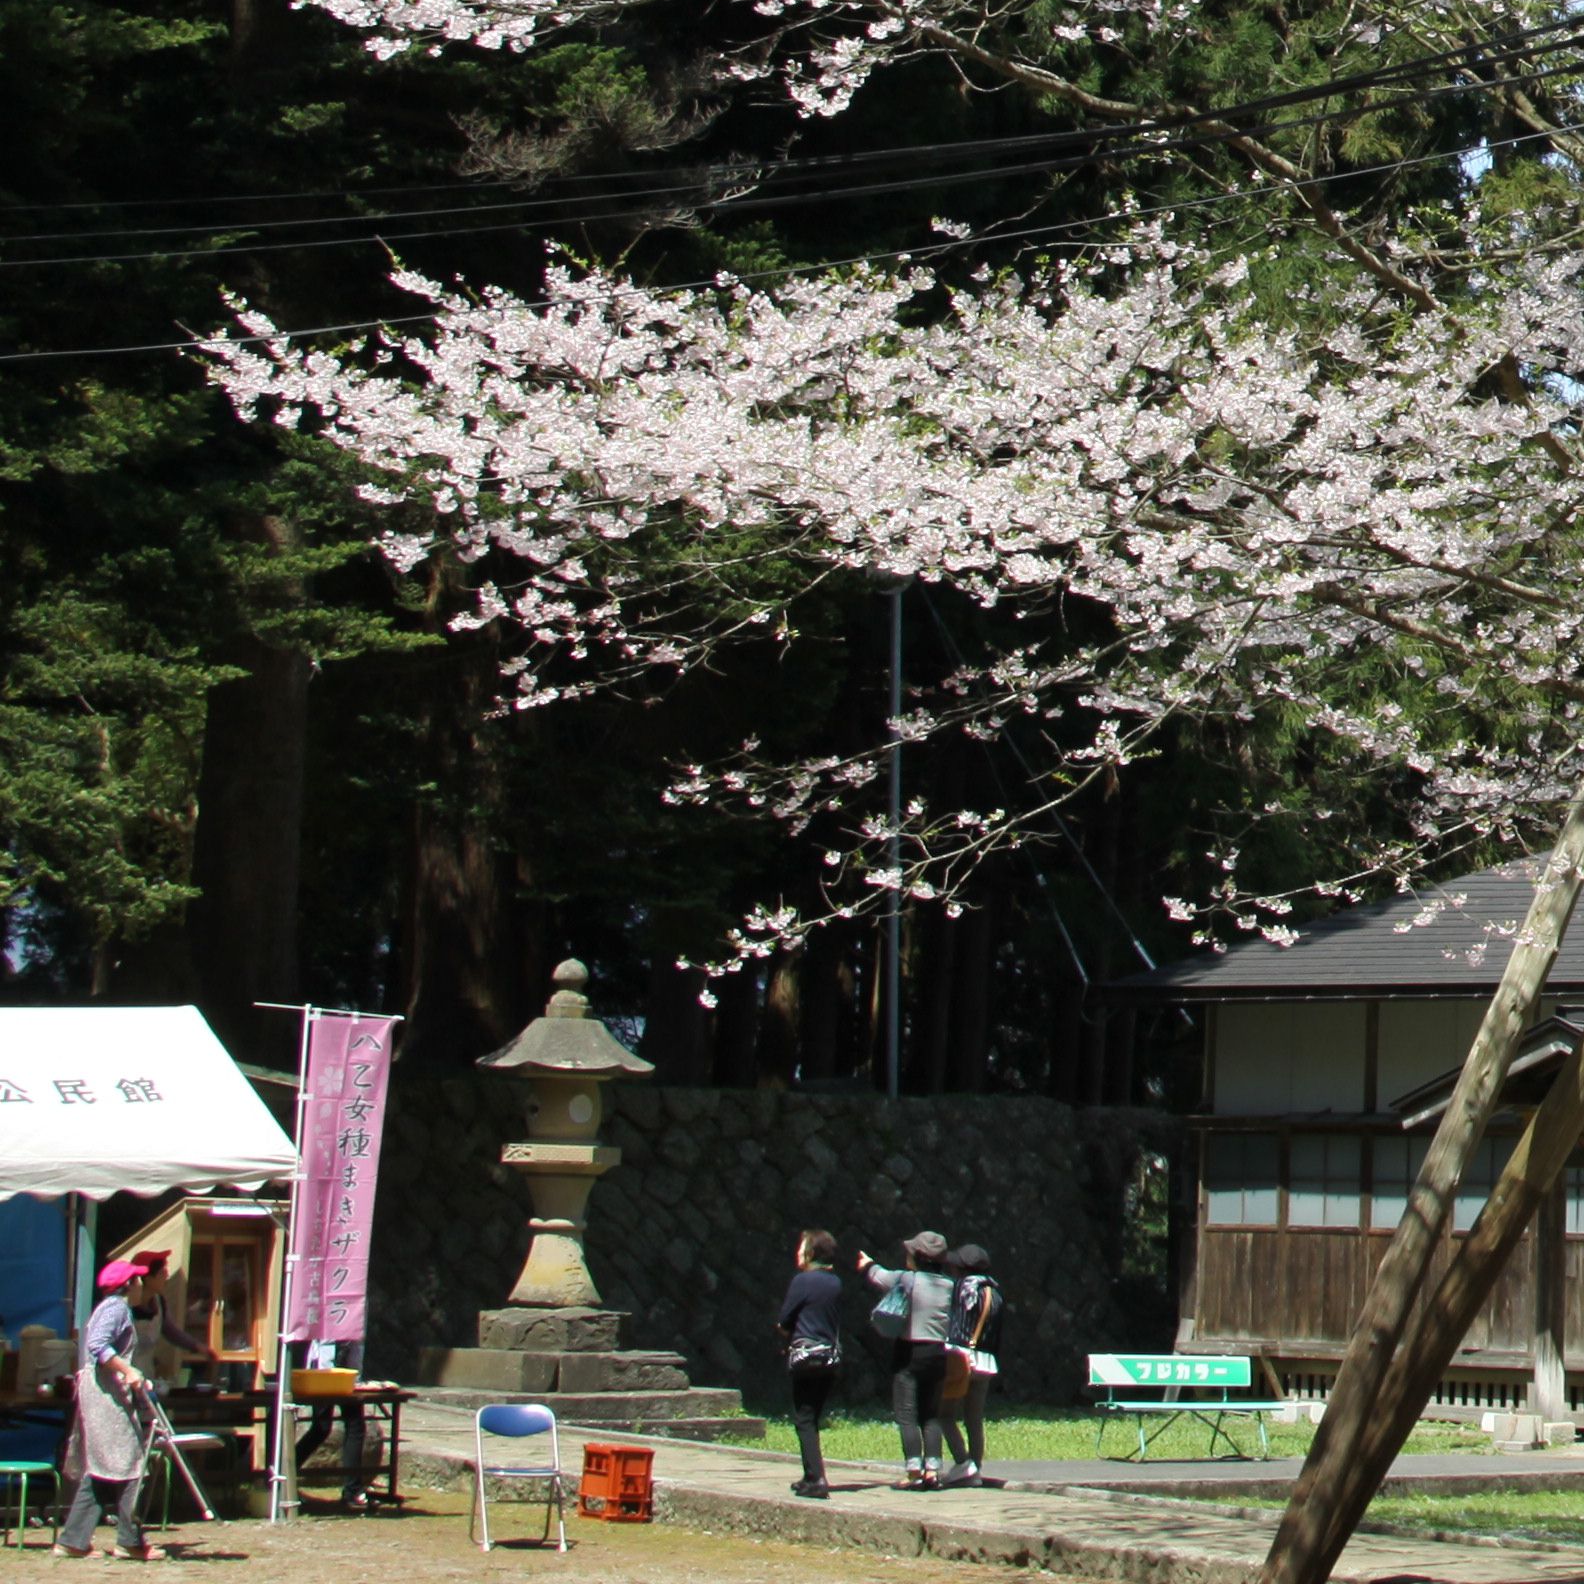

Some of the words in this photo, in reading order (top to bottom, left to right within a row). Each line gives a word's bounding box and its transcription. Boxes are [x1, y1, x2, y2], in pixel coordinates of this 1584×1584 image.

[0, 1077, 164, 1105] 公民館
[330, 1034, 382, 1325] 八乙女種まきザクラ
[1136, 1361, 1228, 1381] フジカラー
